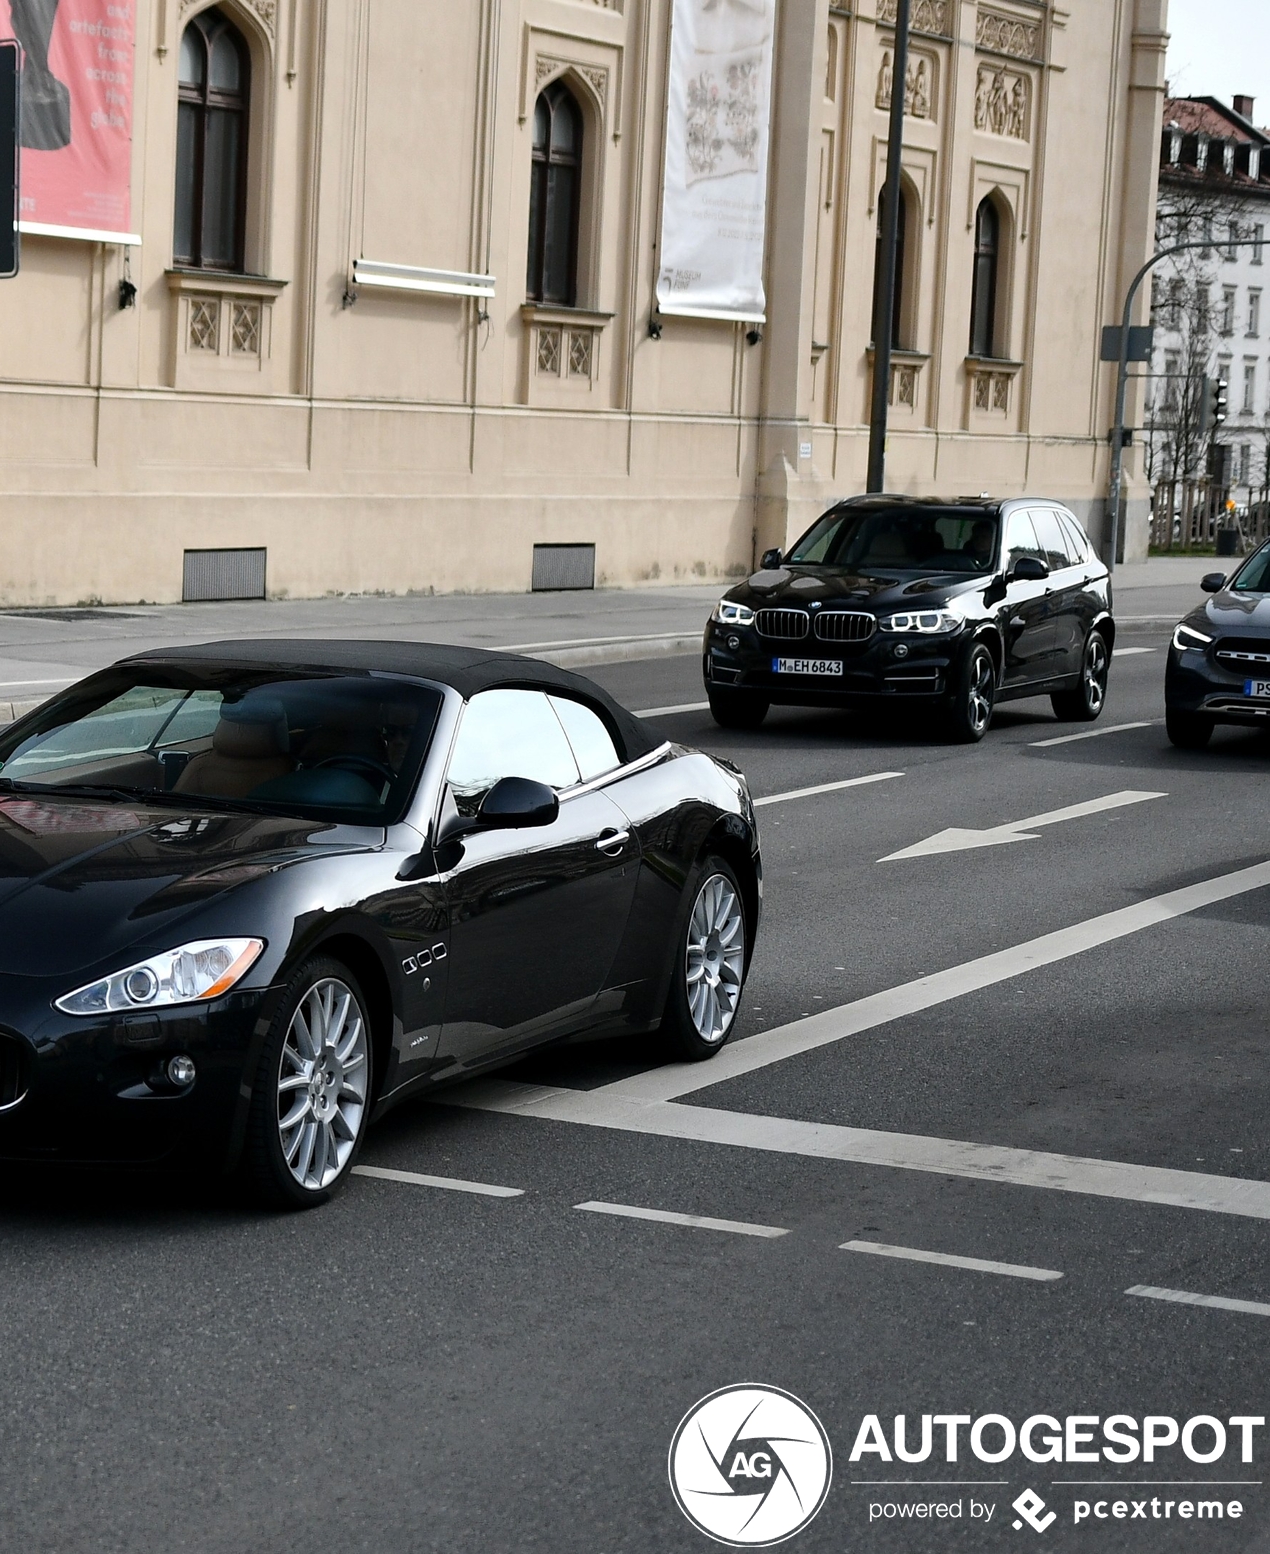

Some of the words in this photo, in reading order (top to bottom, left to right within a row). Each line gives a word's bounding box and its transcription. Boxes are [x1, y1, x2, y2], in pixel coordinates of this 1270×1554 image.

[107, 3, 130, 18] and
[98, 41, 128, 62] from
[86, 67, 127, 84] across
[675, 269, 702, 281] MUSEUM
[779, 659, 787, 671] M
[811, 661, 841, 674] 6843
